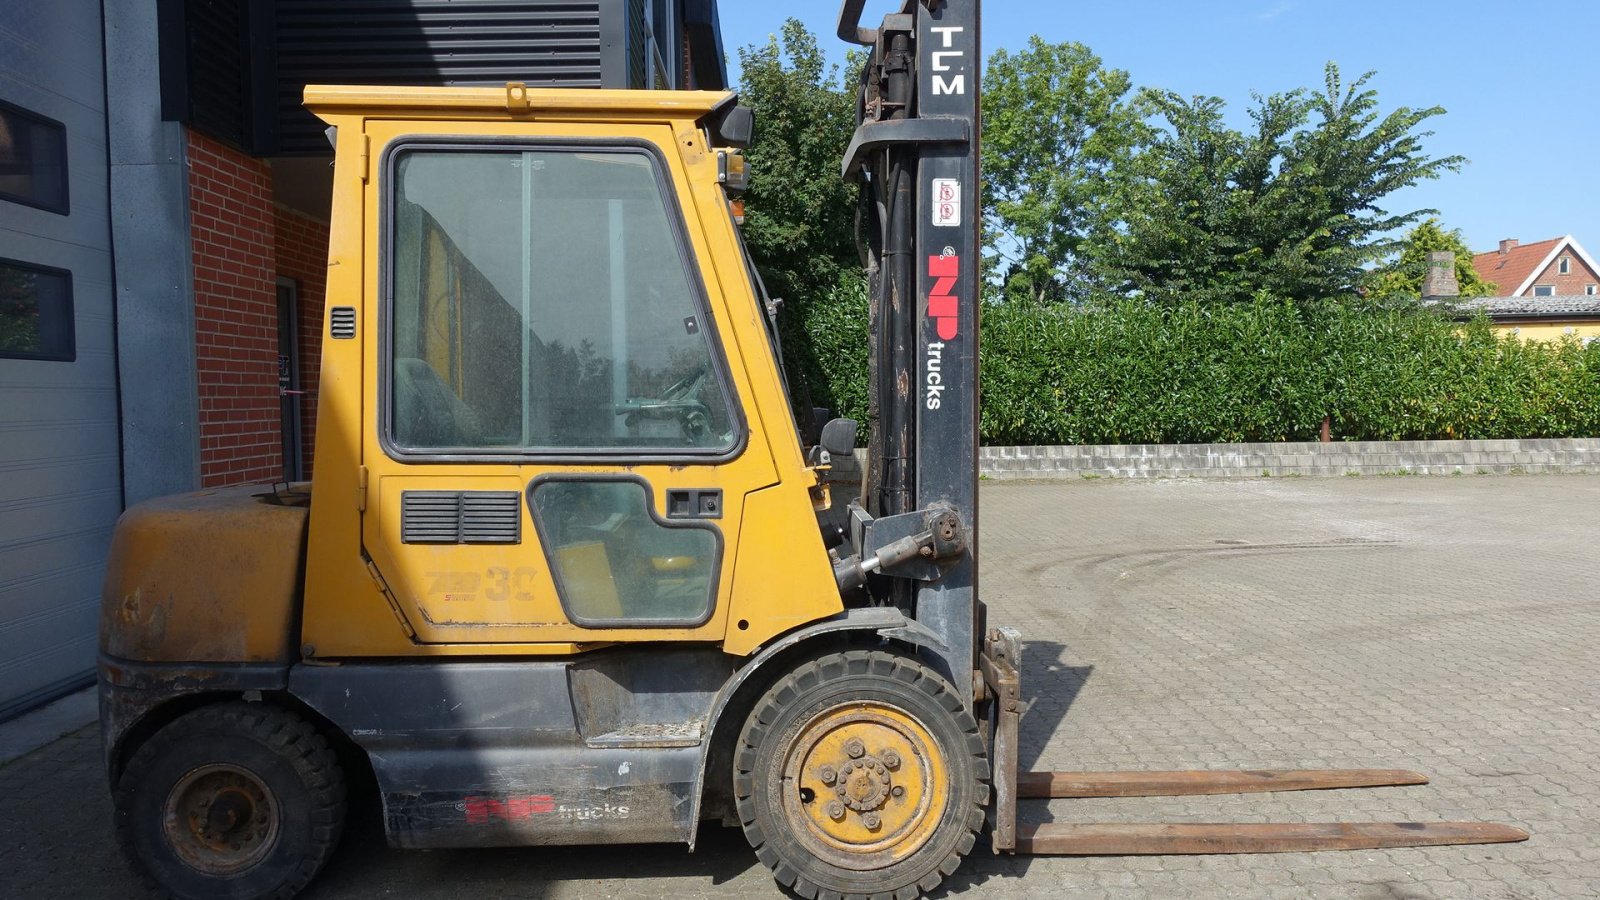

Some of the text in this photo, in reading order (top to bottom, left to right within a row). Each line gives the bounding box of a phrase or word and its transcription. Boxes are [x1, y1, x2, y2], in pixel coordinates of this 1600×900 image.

[930, 26, 965, 95] TCM
[926, 341, 945, 410] trucks
[558, 802, 631, 820] trucks
